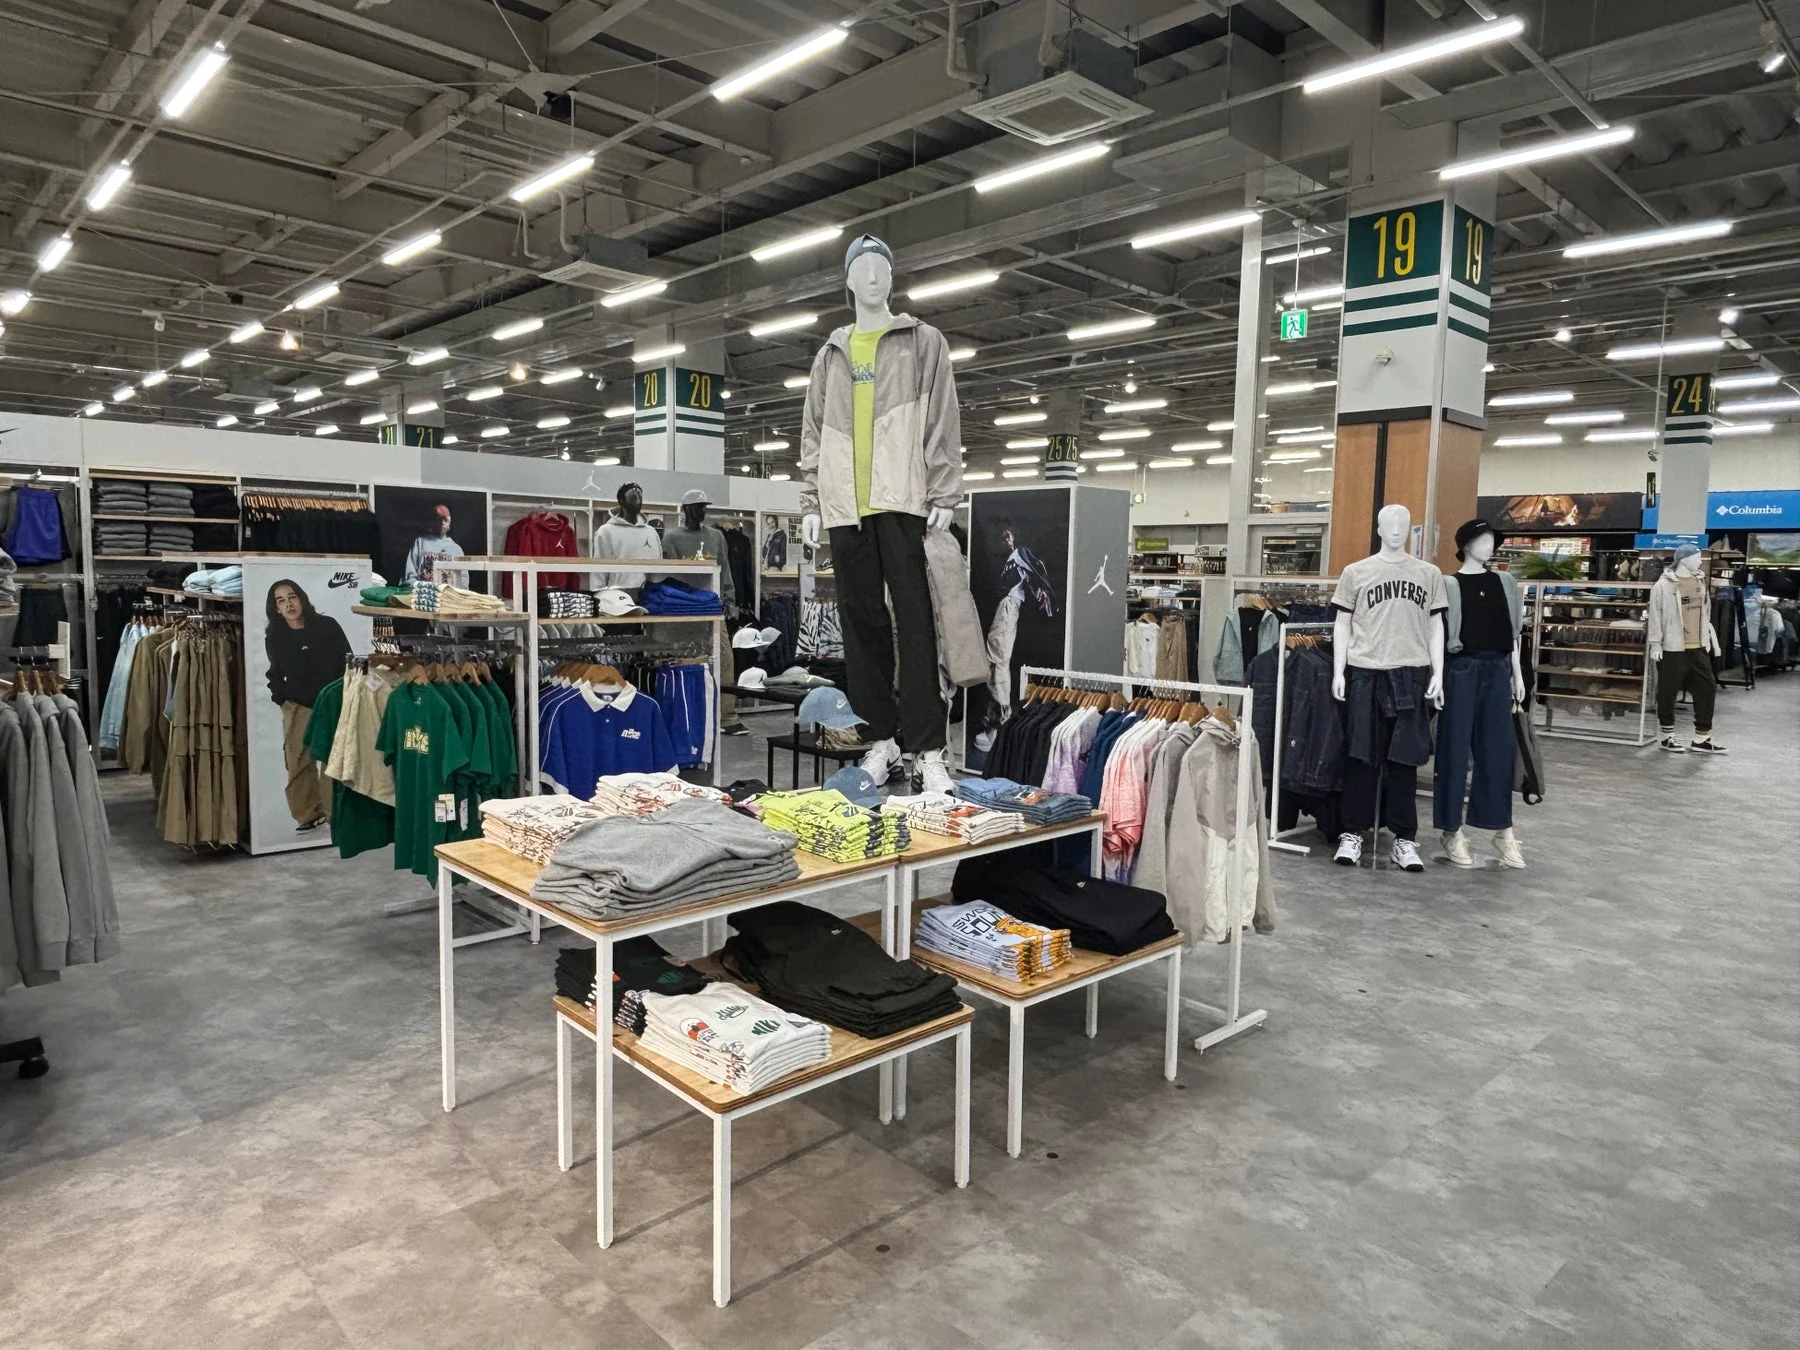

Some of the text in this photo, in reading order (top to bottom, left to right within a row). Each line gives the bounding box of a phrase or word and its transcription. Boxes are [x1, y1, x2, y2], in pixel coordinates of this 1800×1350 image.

[1373, 211, 1416, 279] 19
[1465, 217, 1483, 285] 19
[643, 372, 658, 407] 20
[689, 373, 711, 408] 20
[1671, 376, 1703, 414] 24
[416, 426, 433, 448] 21
[1048, 435, 1063, 461] 25
[1066, 436, 1078, 461] 25
[1728, 504, 1783, 515] Columbia
[333, 571, 355, 581] NIKE
[347, 581, 359, 589] SB
[1367, 580, 1428, 610] CONVERSE
